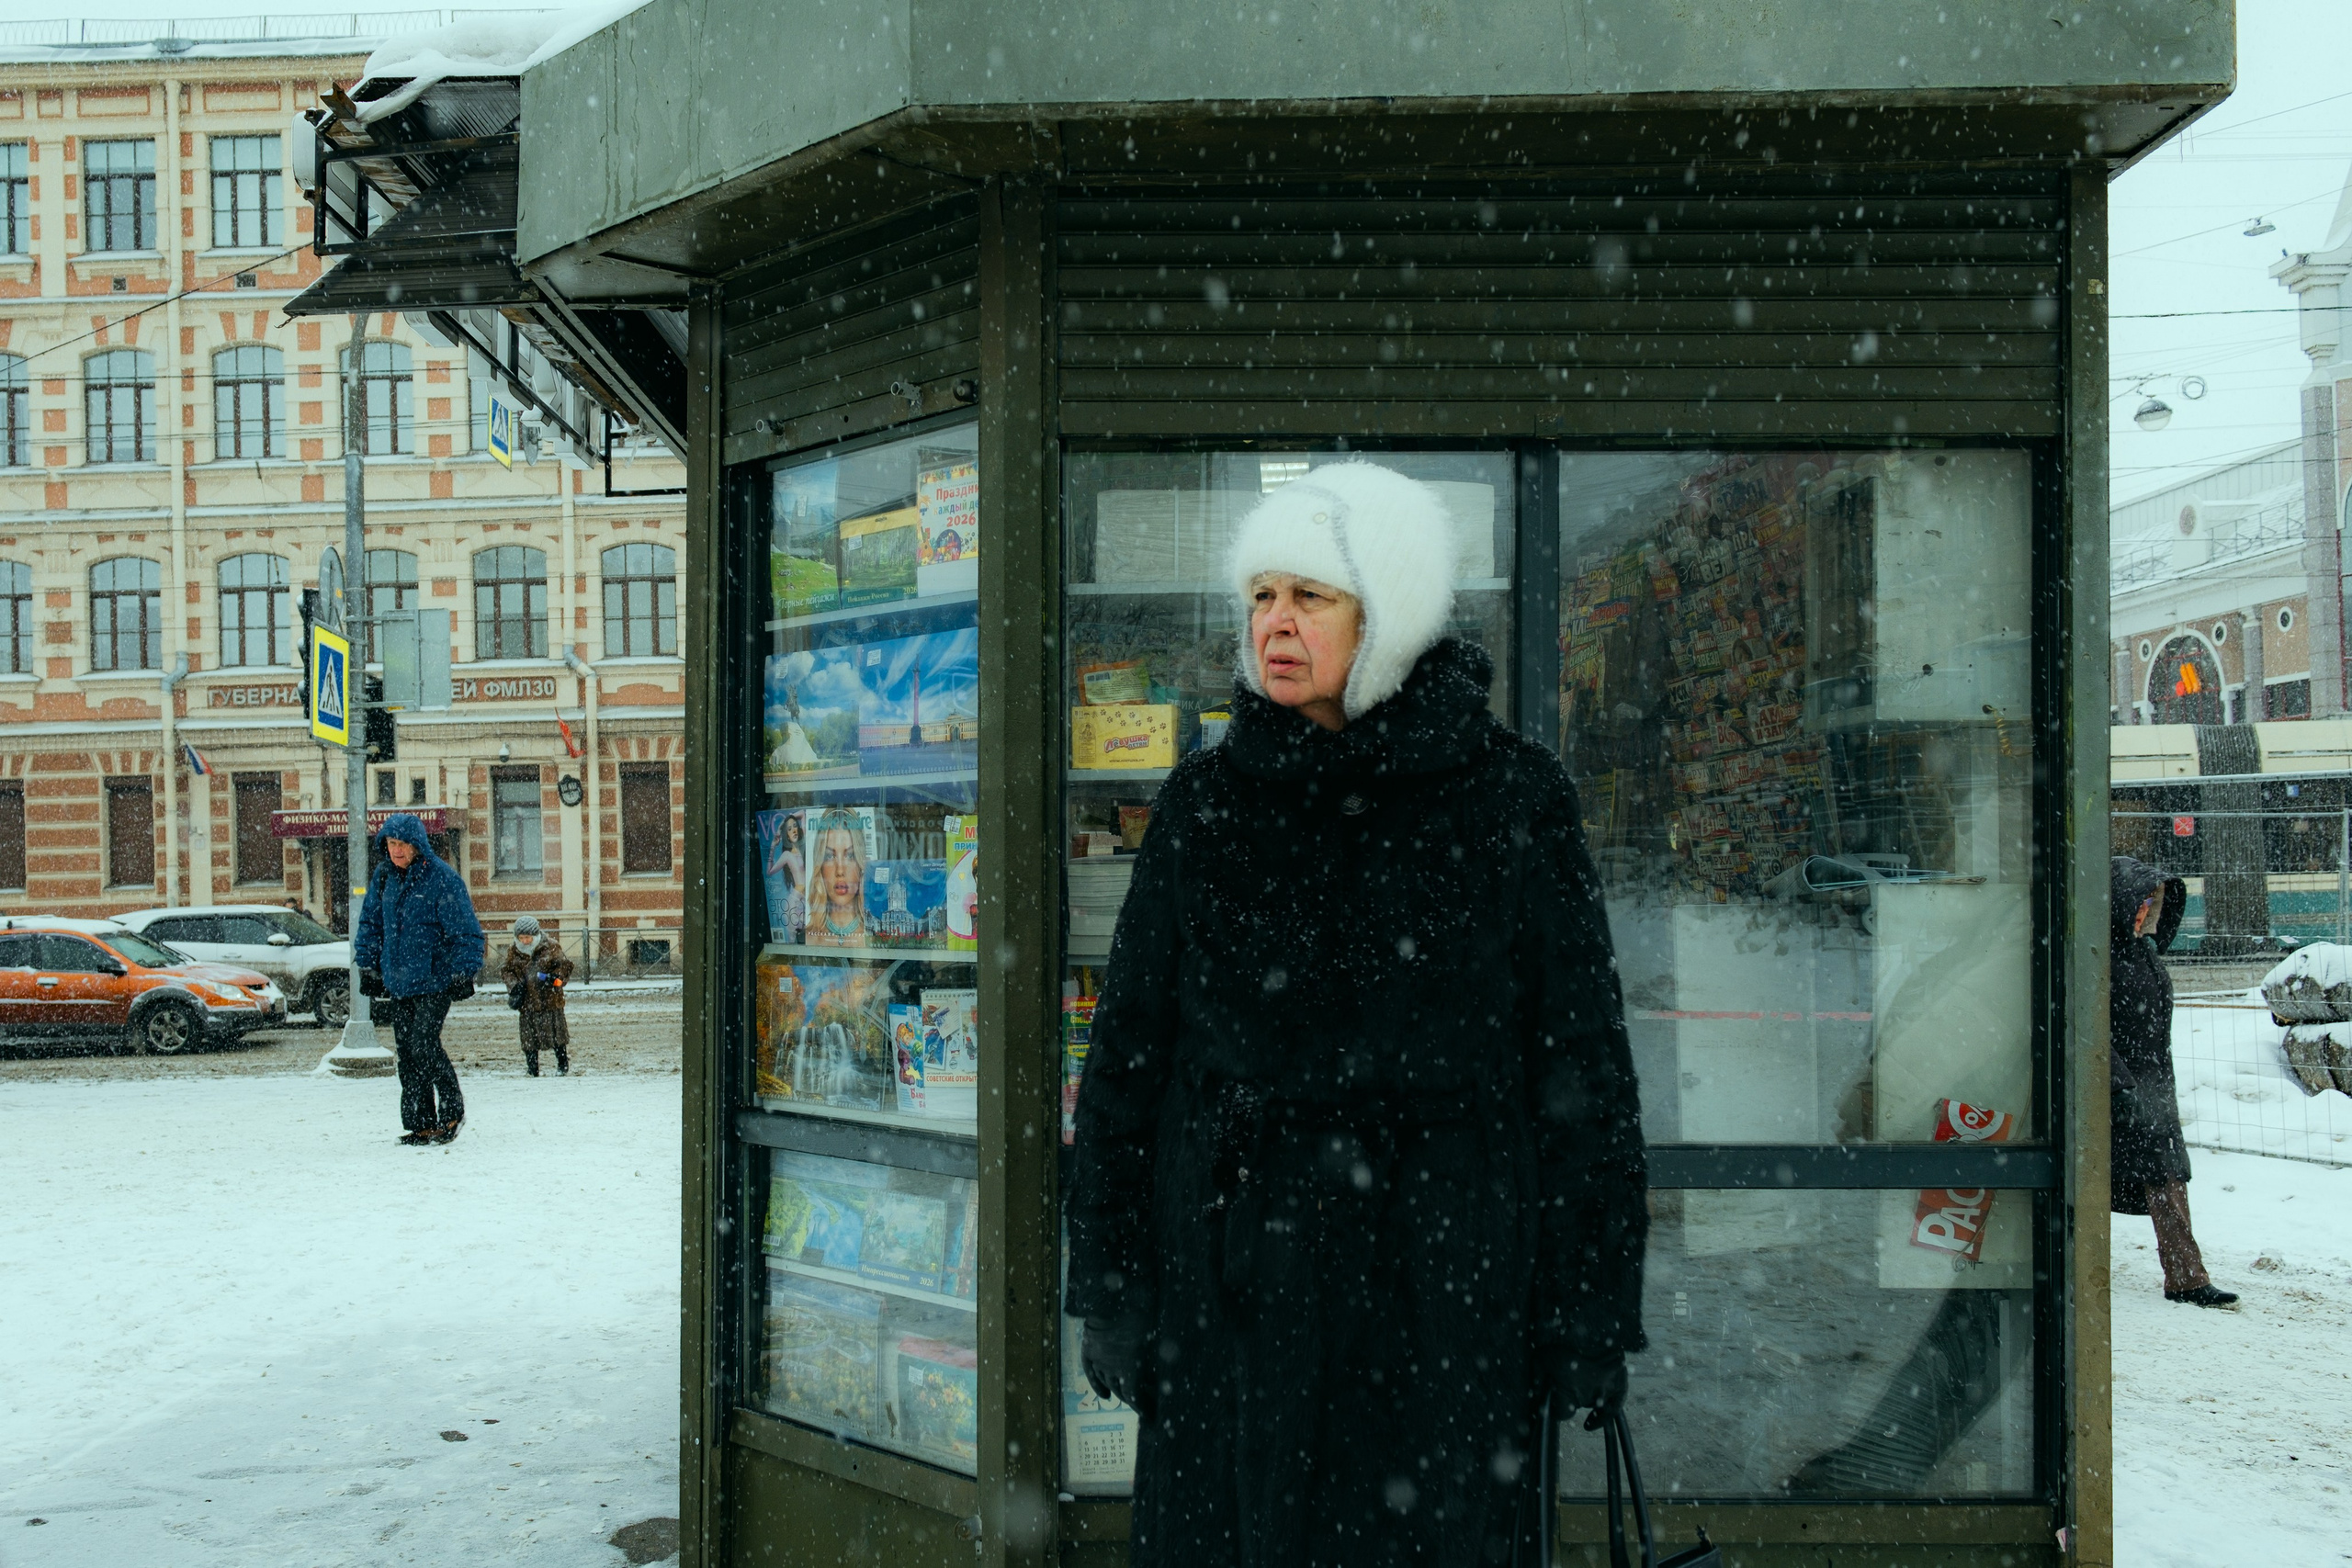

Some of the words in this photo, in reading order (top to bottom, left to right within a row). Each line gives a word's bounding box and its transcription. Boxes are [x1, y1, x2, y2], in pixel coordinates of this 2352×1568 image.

[947, 511, 976, 527] 2026
[903, 586, 917, 595] 2026
[483, 679, 555, 698] ФМЛ30
[808, 815, 839, 831] marie
[842, 812, 872, 831] claire
[920, 1277, 934, 1288] 2026
